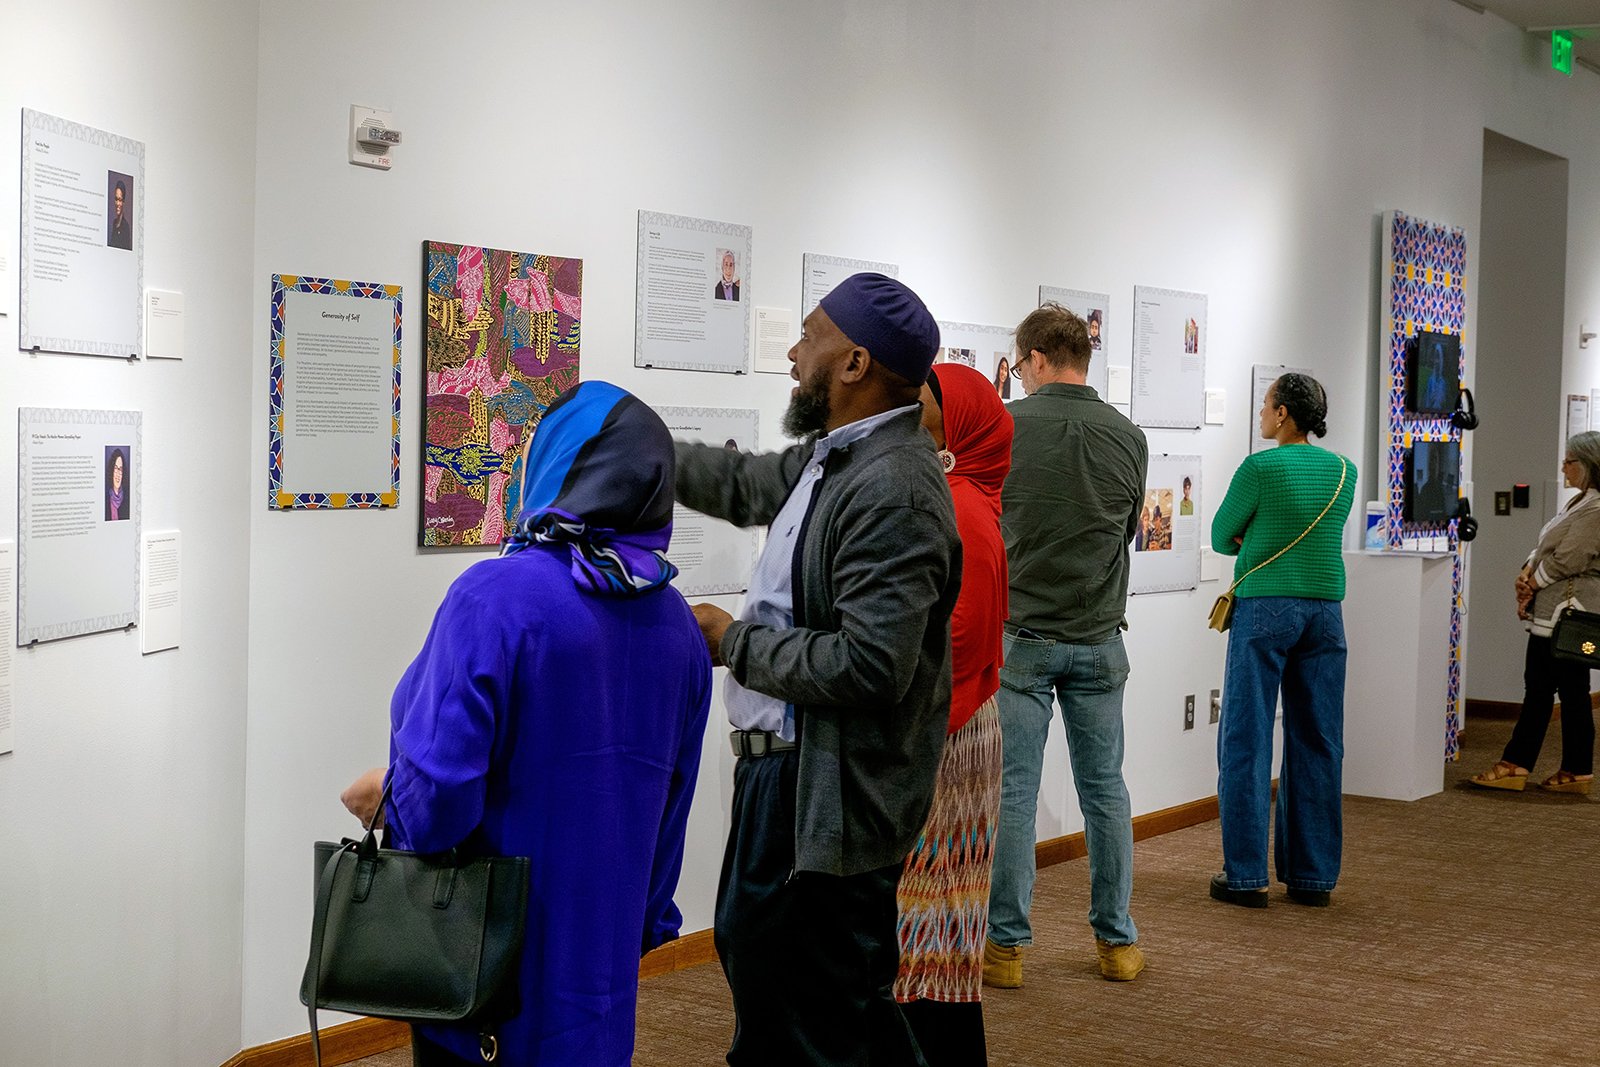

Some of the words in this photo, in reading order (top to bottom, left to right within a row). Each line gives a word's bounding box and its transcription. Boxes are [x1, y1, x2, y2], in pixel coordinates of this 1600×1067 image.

[378, 157, 391, 166] FIRE
[321, 311, 345, 322] Generosity
[345, 313, 351, 322] of
[351, 313, 360, 323] Self
